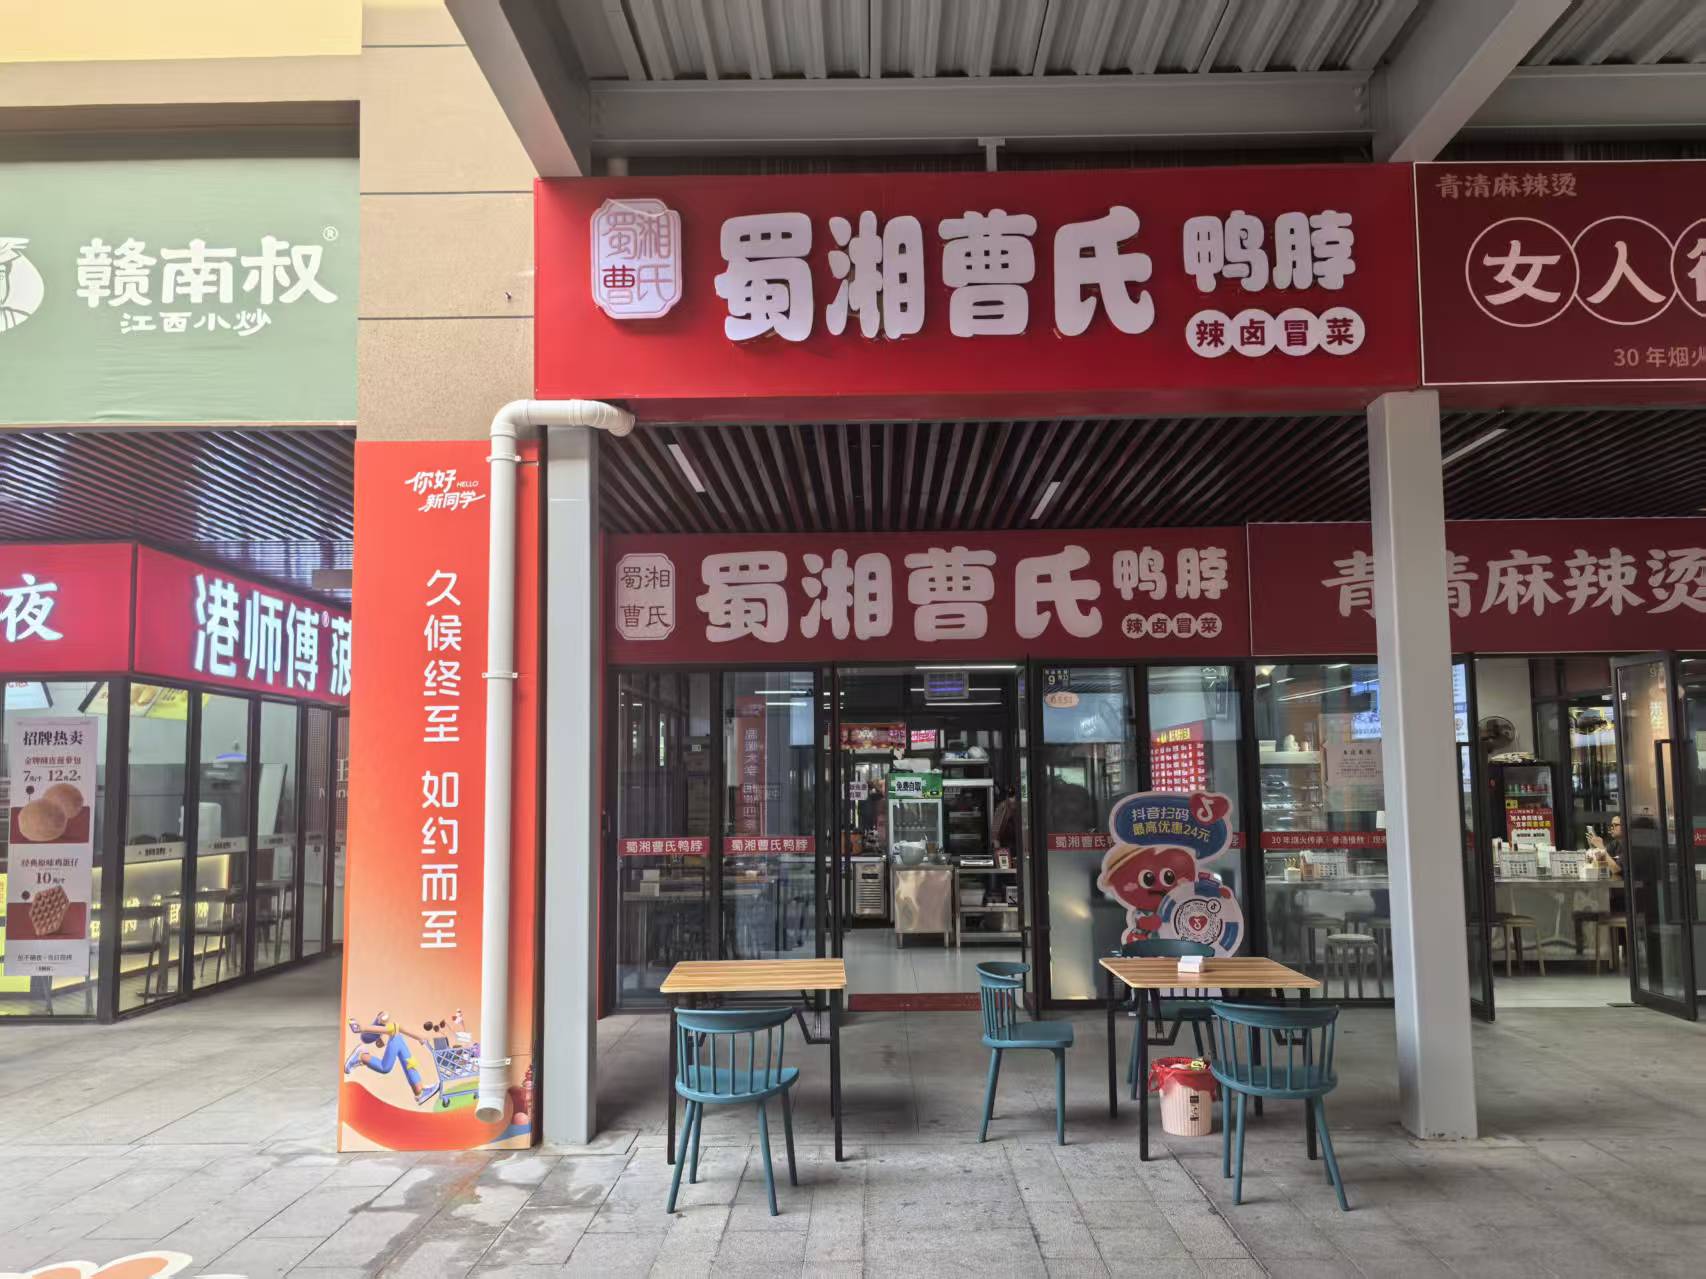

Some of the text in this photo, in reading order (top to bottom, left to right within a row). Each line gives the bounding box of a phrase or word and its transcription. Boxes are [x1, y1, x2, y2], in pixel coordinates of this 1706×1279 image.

[1435, 173, 1577, 199] 青清麻辣烫
[76, 234, 339, 308] 赣南叔
[714, 205, 1356, 342] 蜀湘曹氏 鸭脖
[1483, 238, 1706, 305] 女人
[120, 308, 272, 337] 江西小炒
[1195, 317, 1354, 348] 辣卤冒菜
[1613, 349, 1639, 366] 30
[404, 469, 480, 495] 你好 HELLO
[418, 490, 486, 513] 新同学
[619, 566, 671, 590] 蜀湘
[1321, 547, 1706, 618] 青麻辣烫
[695, 544, 1229, 643] 蜀湘曹氏 鸭脖
[619, 603, 671, 628] 曹氏
[1126, 617, 1218, 635] 辣卤冒菜
[23, 730, 83, 746] 招牌热卖
[419, 569, 463, 949] 久候终至 如约而至
[896, 781, 922, 792] 免费自取
[1131, 806, 1190, 821] 抖音扫码
[1132, 820, 1211, 842] 最高优惠24元
[626, 839, 703, 853] 蜀湘曹氏鸭脖
[731, 838, 809, 852] 蜀湘曹氏鸭脖
